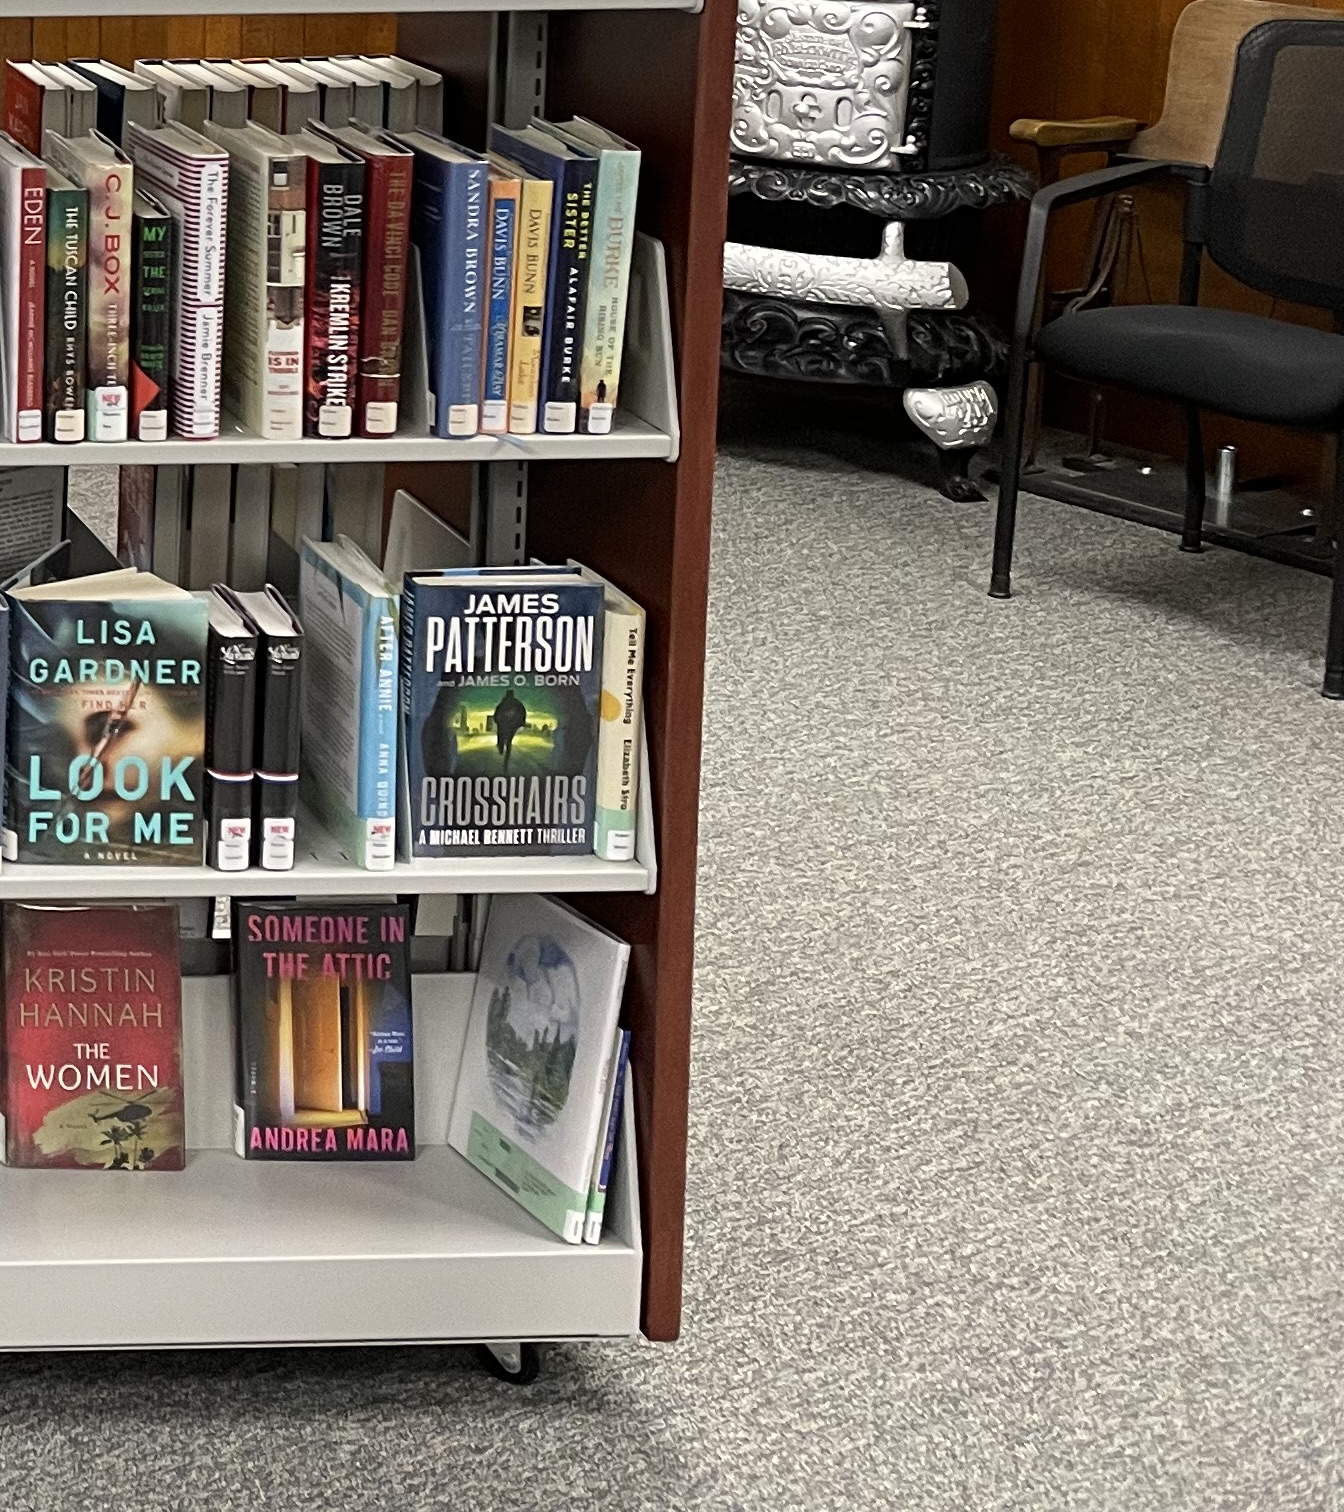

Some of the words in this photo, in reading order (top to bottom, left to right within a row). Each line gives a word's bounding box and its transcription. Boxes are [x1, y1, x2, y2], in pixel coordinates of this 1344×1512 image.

[210, 170, 220, 194] The
[23, 187, 44, 246] EDEN
[64, 206, 79, 229] THE
[206, 195, 219, 243] Forever
[321, 184, 344, 248] BROWN
[341, 194, 363, 238] DALE
[466, 168, 481, 241] SANDRA
[563, 192, 579, 250] SISTER
[143, 226, 167, 241] MY
[493, 207, 510, 252] DAVIS
[526, 209, 543, 249] DAVIS
[64, 233, 79, 286] TUSCAN
[103, 234, 121, 295] BOX
[143, 266, 167, 278] THE
[202, 245, 217, 297] Summer
[491, 256, 508, 301] BUNN
[523, 254, 539, 295] BUNN
[462, 248, 479, 314] BROWN
[64, 289, 78, 331] CHILD
[327, 283, 351, 350] KREMLIN
[464, 594, 560, 615] JAMES
[77, 620, 156, 645] LISA
[378, 615, 395, 663] AFTER
[426, 615, 594, 673] PATTERSON
[29, 659, 201, 685] GARDNER
[378, 668, 393, 712] ANNIE
[458, 675, 509, 687] JAMES
[534, 674, 580, 686] BORN
[29, 754, 196, 802] LOOK
[420, 775, 587, 826] CROSSHAIRS
[29, 812, 110, 844] FOR
[135, 812, 194, 845] ME
[429, 830, 481, 846] MICHAEL
[484, 829, 533, 845] BENNETT
[537, 828, 585, 844] THRILLER
[97, 852, 138, 861] NOVEL
[247, 914, 368, 944] SOMEONE
[381, 917, 405, 942] IN
[25, 967, 156, 993] KRISTIN
[263, 952, 309, 980] THE
[321, 952, 393, 981] ATTIC
[19, 1001, 163, 1028] HANNAH
[73, 1043, 111, 1059] THE
[25, 1064, 160, 1091] WOMEN
[250, 1127, 338, 1152] ANDREA
[346, 1127, 410, 1153] MARA
